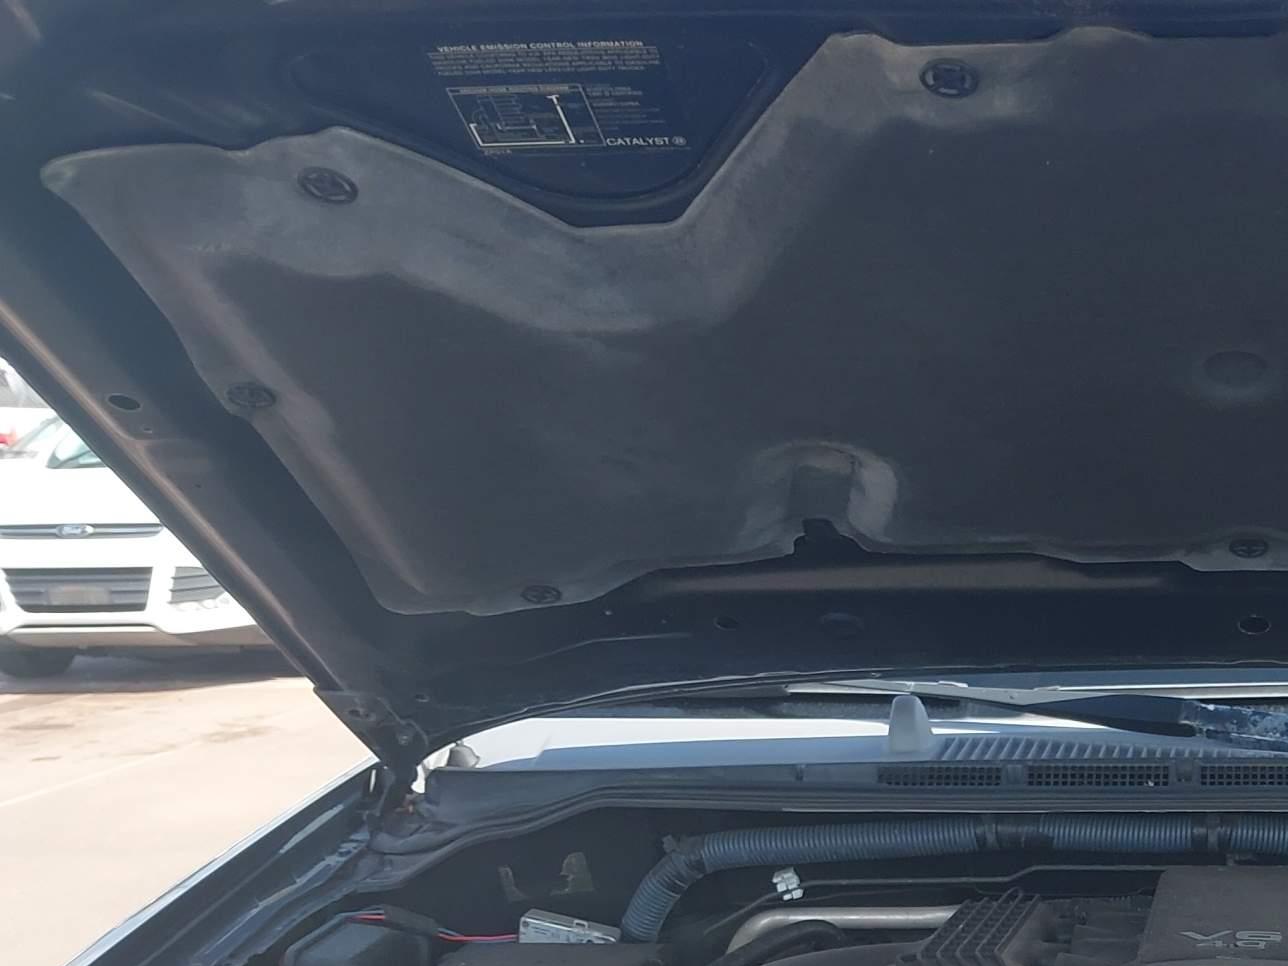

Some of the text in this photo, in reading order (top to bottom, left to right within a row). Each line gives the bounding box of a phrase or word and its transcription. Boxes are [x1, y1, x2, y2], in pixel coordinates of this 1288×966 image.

[437, 45, 477, 53] VEHICLE
[480, 43, 528, 51] EMISSION
[529, 42, 576, 50] CONTROL
[576, 41, 644, 49] INFORMATION
[606, 137, 670, 146] CATALYST
